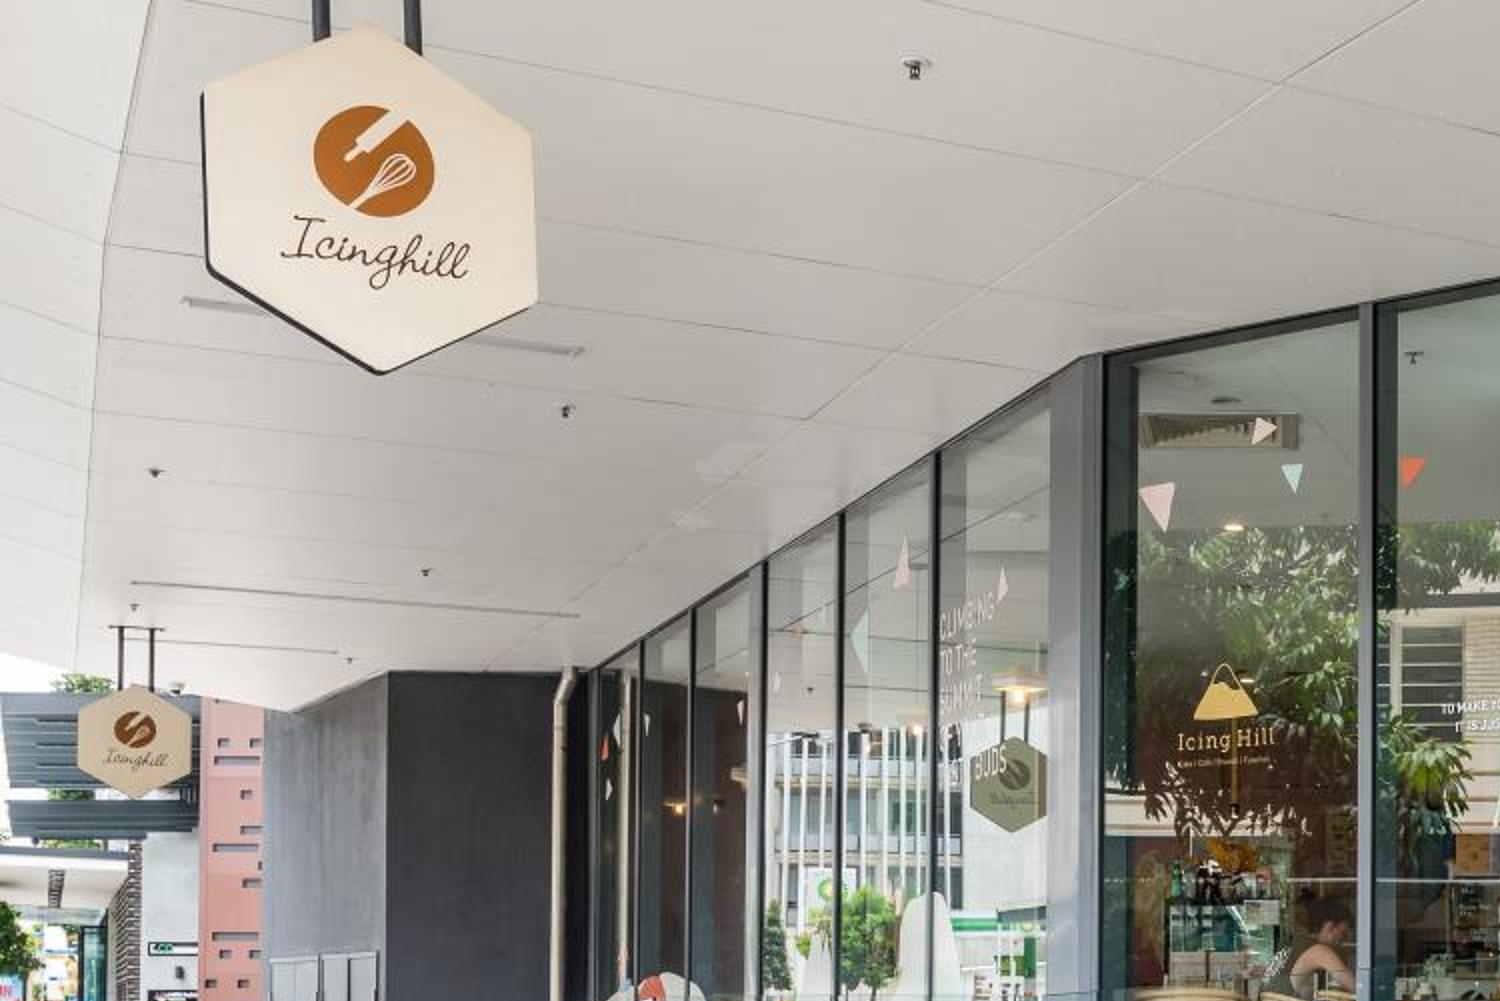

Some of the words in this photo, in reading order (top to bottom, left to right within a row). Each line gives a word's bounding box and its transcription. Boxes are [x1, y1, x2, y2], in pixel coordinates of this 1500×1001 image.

[280, 213, 471, 291] Icinghill
[1441, 702, 1454, 715] TO
[1457, 699, 1489, 714] MAKE
[1177, 732, 1231, 753] Icing
[1237, 726, 1275, 747] Hill
